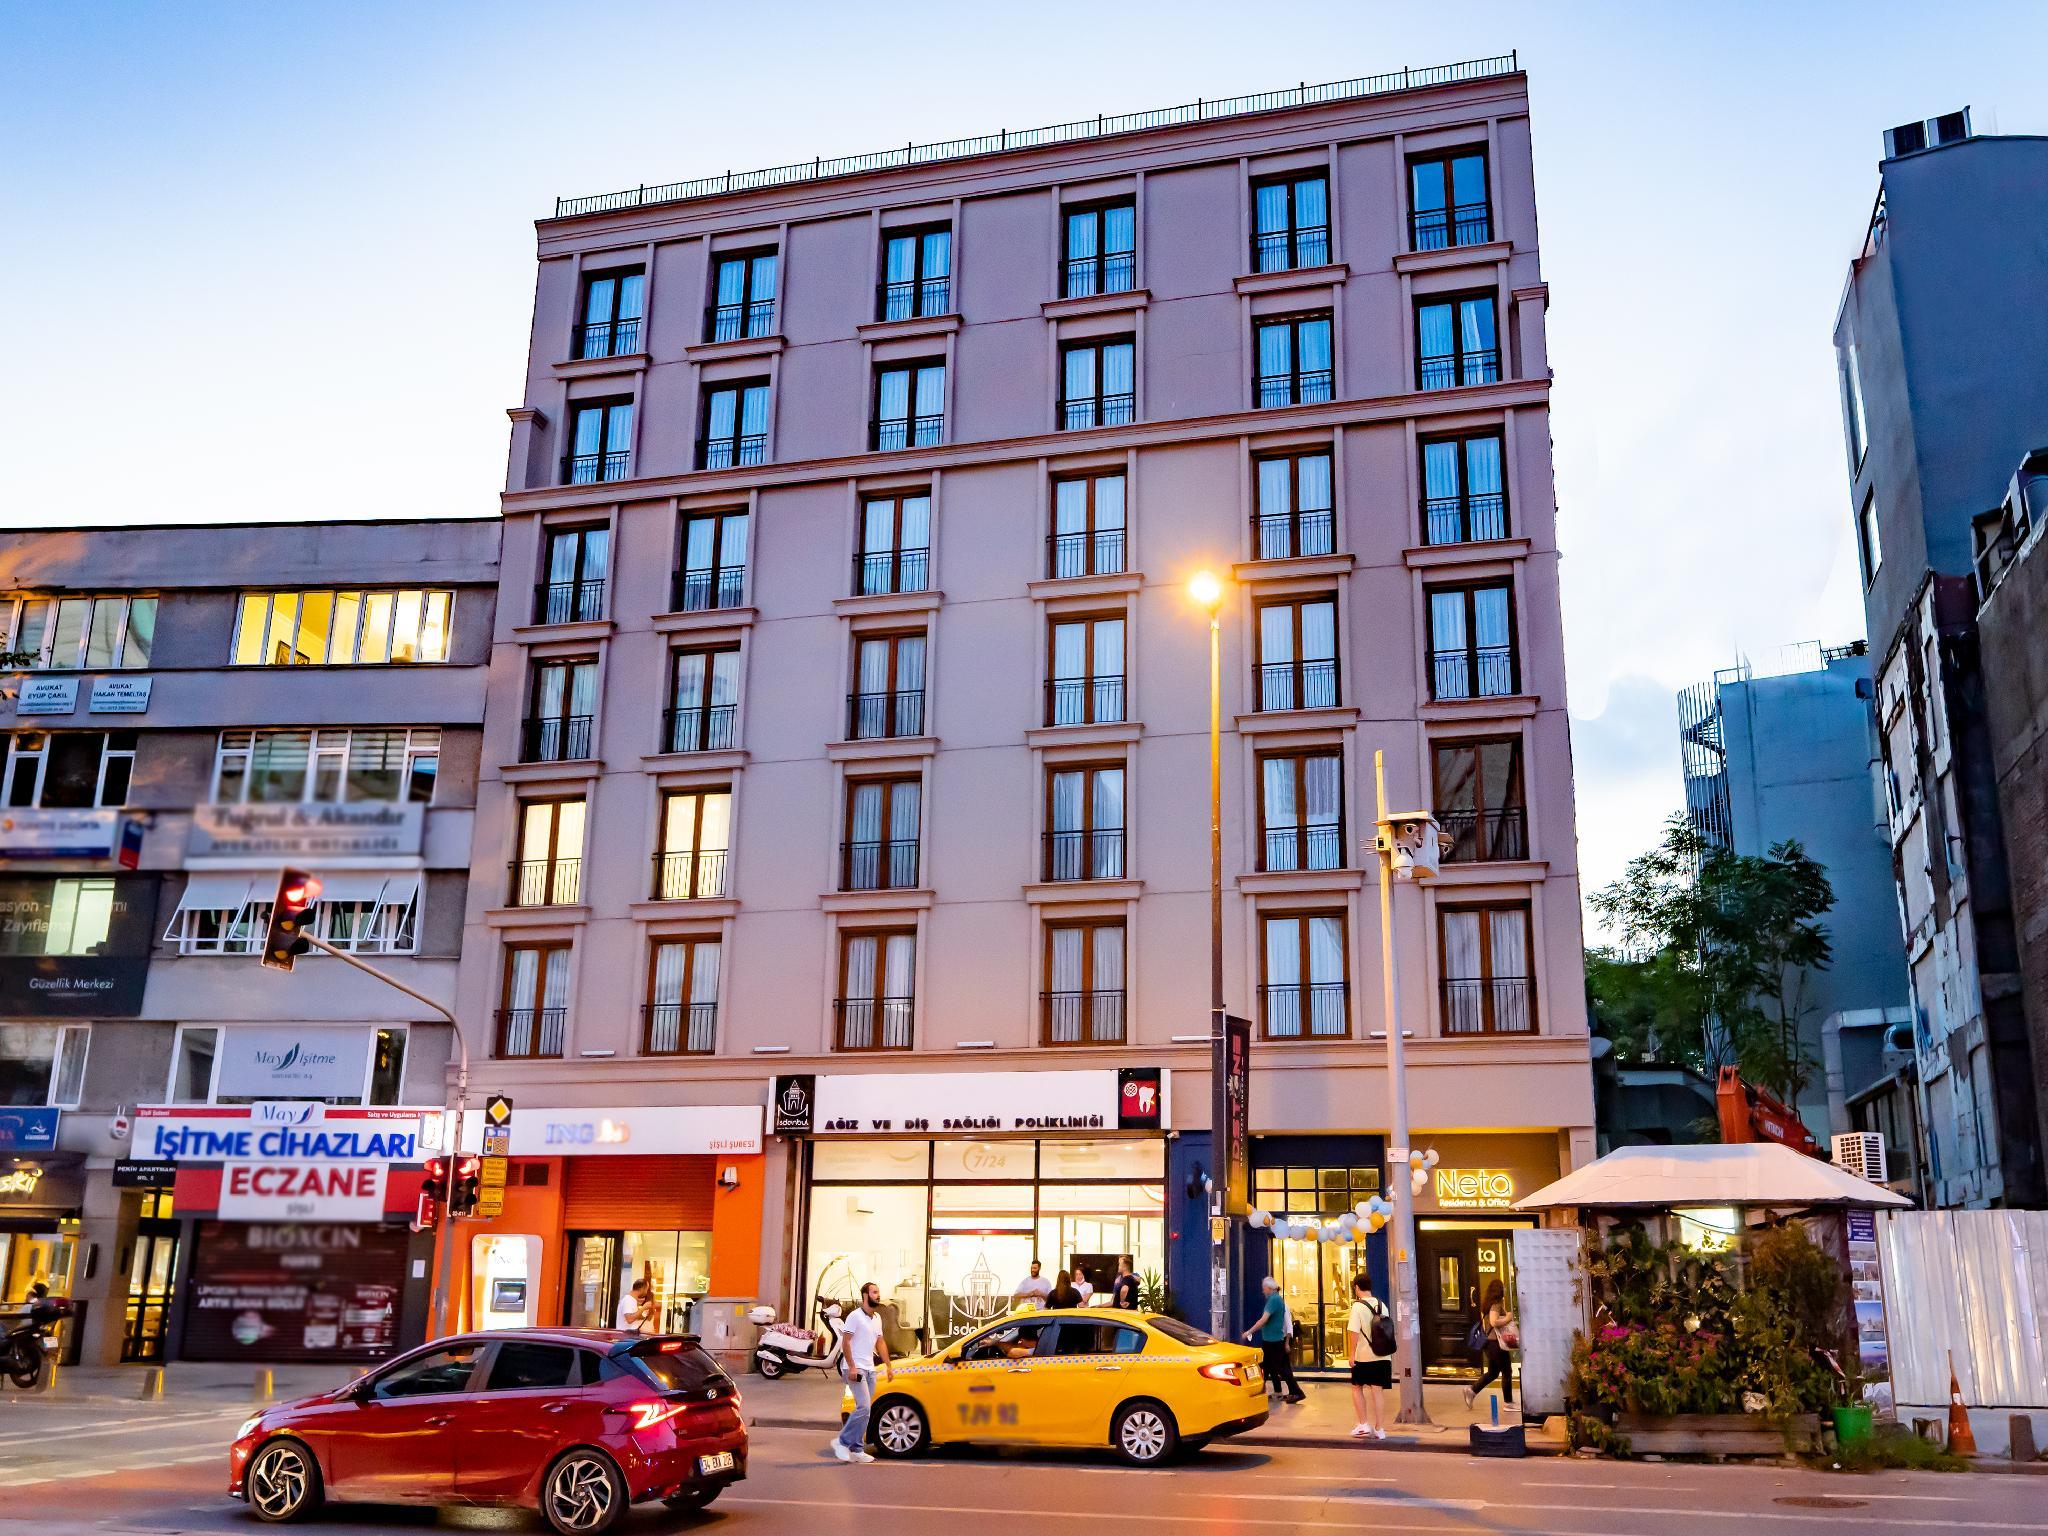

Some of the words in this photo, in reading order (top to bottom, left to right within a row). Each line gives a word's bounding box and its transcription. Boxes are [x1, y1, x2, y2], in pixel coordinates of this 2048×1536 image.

[29, 977, 70, 989] Güzellik
[73, 978, 114, 989] Merkezi
[261, 1104, 297, 1123] May
[824, 1117, 859, 1131] AĞIZ
[871, 1119, 892, 1130] VE
[904, 1117, 930, 1132] DİŞ
[942, 1115, 1001, 1129] SAĞLIĞI
[1014, 1113, 1104, 1129] POLİKLİNİĞİ
[154, 1124, 252, 1161] İŞİTME
[258, 1125, 416, 1158] CİHAZLARI
[545, 1122, 595, 1145] ING
[708, 1138, 728, 1150] ŞİŞLİ
[729, 1138, 756, 1150] ŞUBESİ
[973, 1154, 1006, 1168] 7/24
[229, 1166, 378, 1197] ECZANE
[1437, 1168, 1512, 1197] Neta
[1439, 1198, 1477, 1208] Residence
[1478, 1199, 1486, 1208] &
[1487, 1198, 1511, 1208] Office
